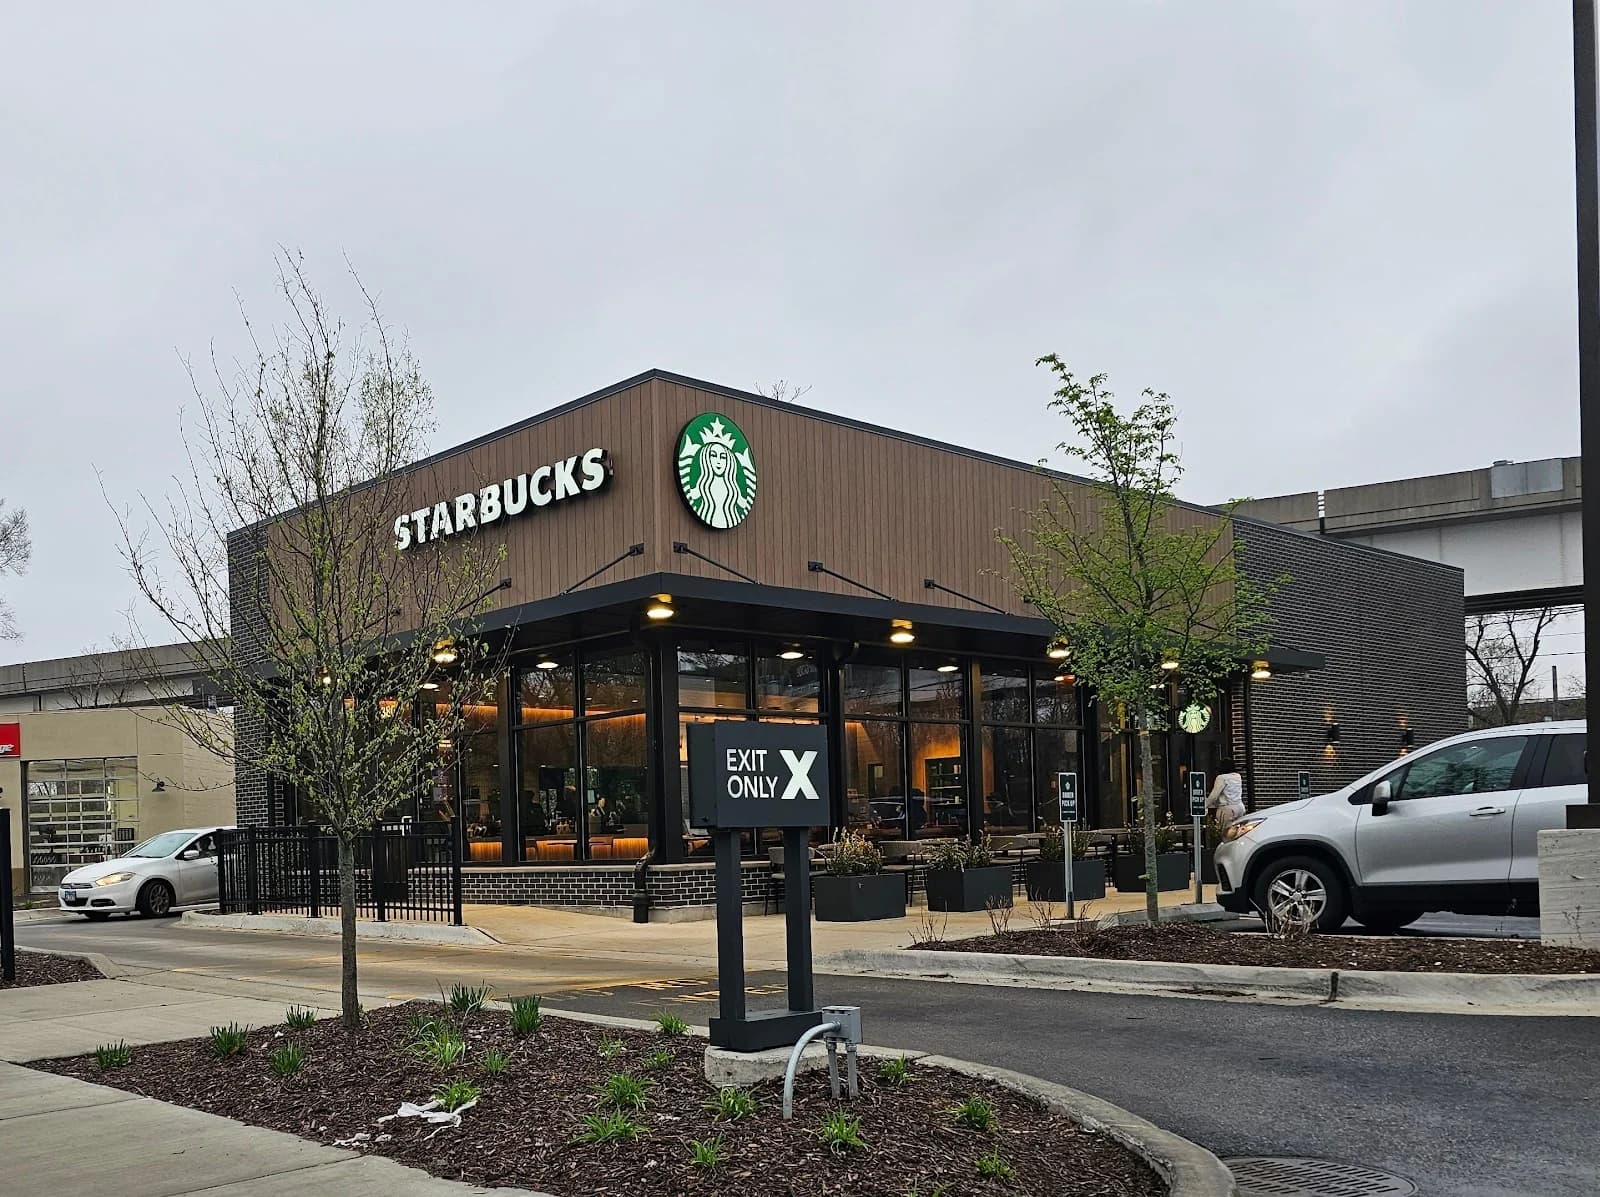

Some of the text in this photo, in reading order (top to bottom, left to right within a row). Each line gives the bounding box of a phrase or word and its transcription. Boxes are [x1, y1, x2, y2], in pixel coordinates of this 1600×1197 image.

[394, 448, 605, 551] STARBUCKS
[726, 748, 768, 772] EXIT
[779, 749, 820, 800] X
[727, 775, 778, 799] ONLY
